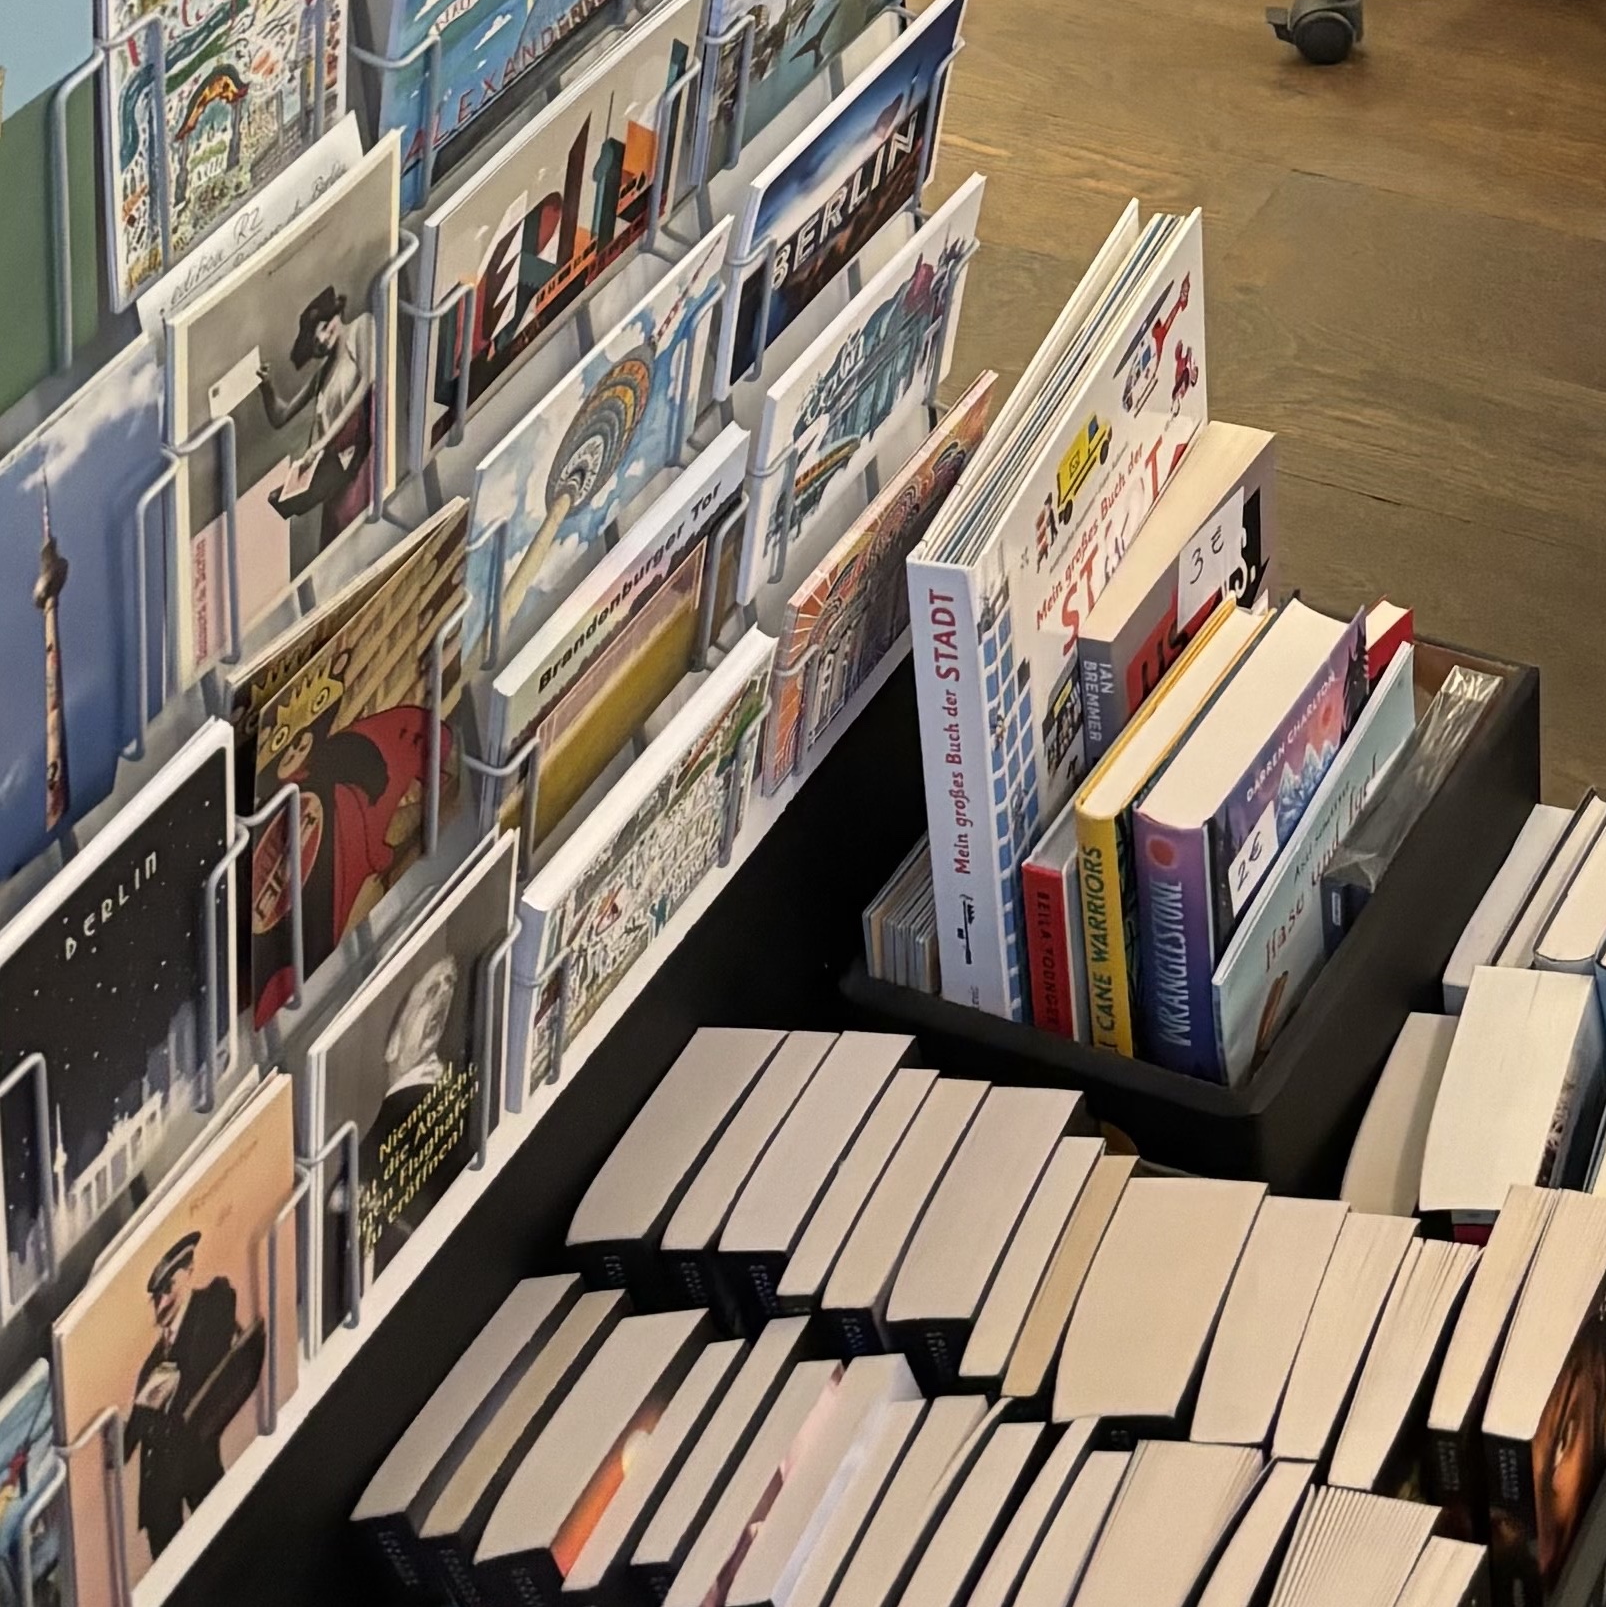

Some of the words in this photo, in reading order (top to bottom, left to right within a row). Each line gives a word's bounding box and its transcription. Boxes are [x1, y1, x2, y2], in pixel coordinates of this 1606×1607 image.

[771, 114, 917, 291] BERLIN
[1037, 585, 1063, 631] Mein
[1064, 519, 1099, 583] großes
[1099, 471, 1127, 521] Buch
[1127, 444, 1144, 481] der
[538, 523, 686, 696] Brandenburger
[691, 481, 723, 523] Tor
[929, 589, 961, 683] STADT
[943, 689, 960, 715] der
[1083, 659, 1103, 742] BREMMER
[1099, 661, 1114, 695] IAN
[944, 722, 965, 771] Buch
[1246, 742, 1287, 803] DARREN
[1286, 667, 1337, 745] CHARLTON
[946, 774, 974, 842] großes
[953, 845, 972, 876] Mein
[1083, 846, 1107, 964] WARRIORS
[1097, 973, 1118, 1033] CANE
[1156, 880, 1194, 1048] WRANGLESTONE
[380, 1061, 453, 1164] Niemand
